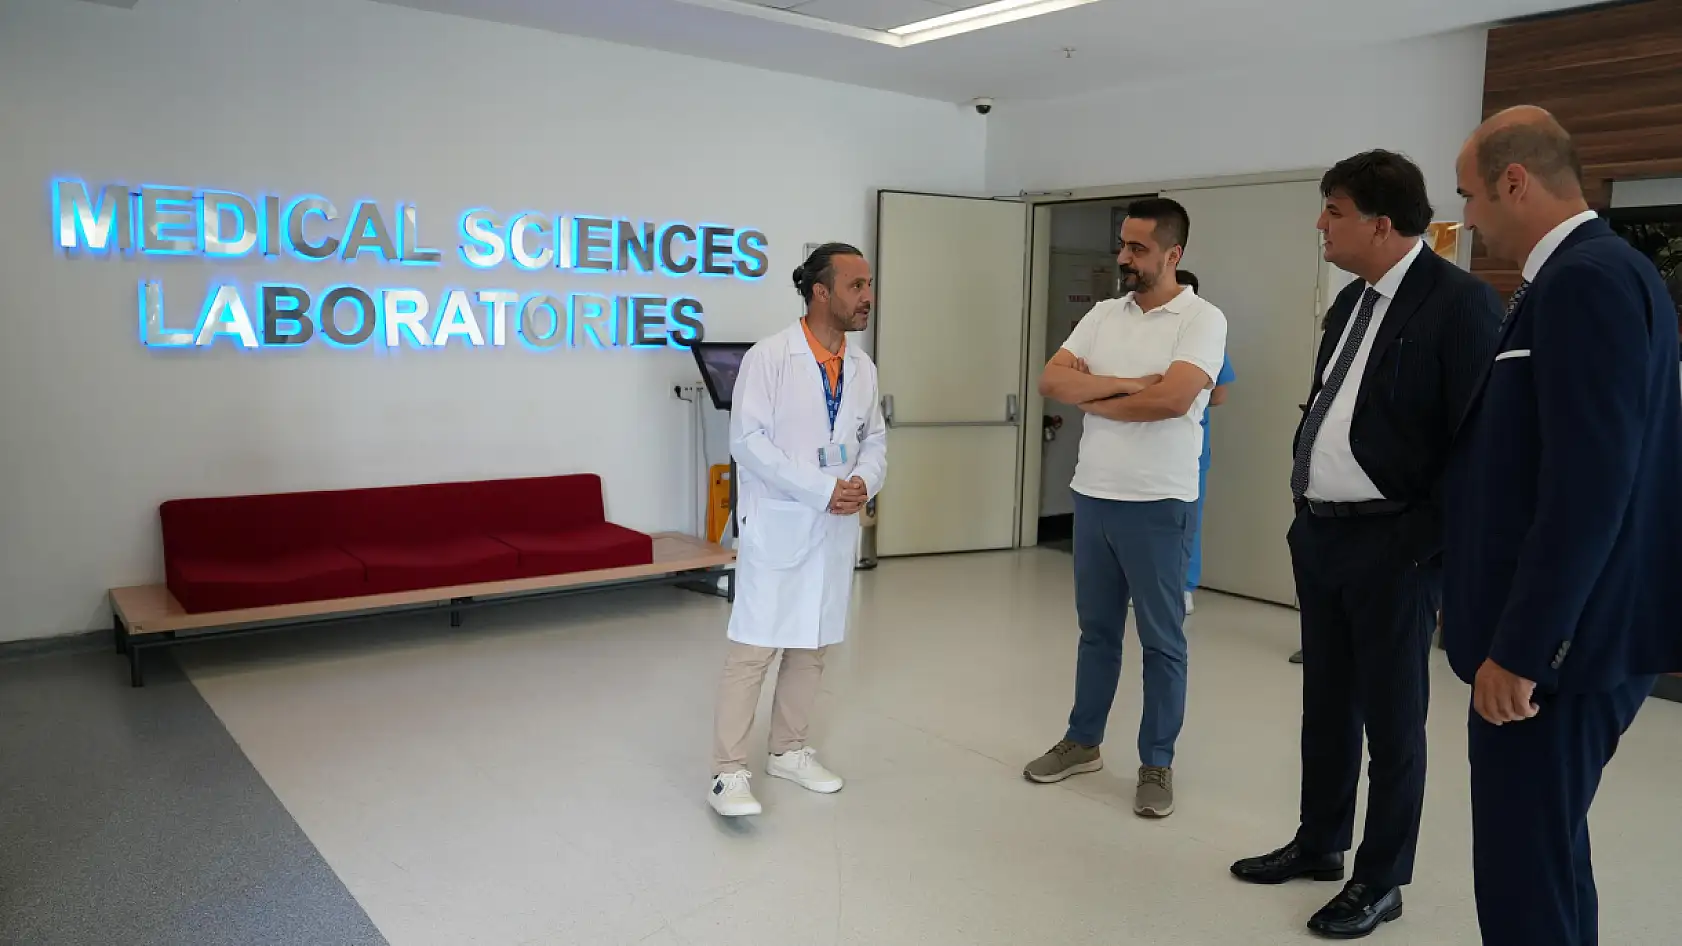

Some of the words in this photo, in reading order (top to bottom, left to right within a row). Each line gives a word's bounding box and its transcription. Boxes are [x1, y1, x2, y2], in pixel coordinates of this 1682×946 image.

[56, 181, 442, 262] MEDICAL
[460, 209, 769, 278] SCIENCES
[144, 283, 705, 348] LABORATORIES
